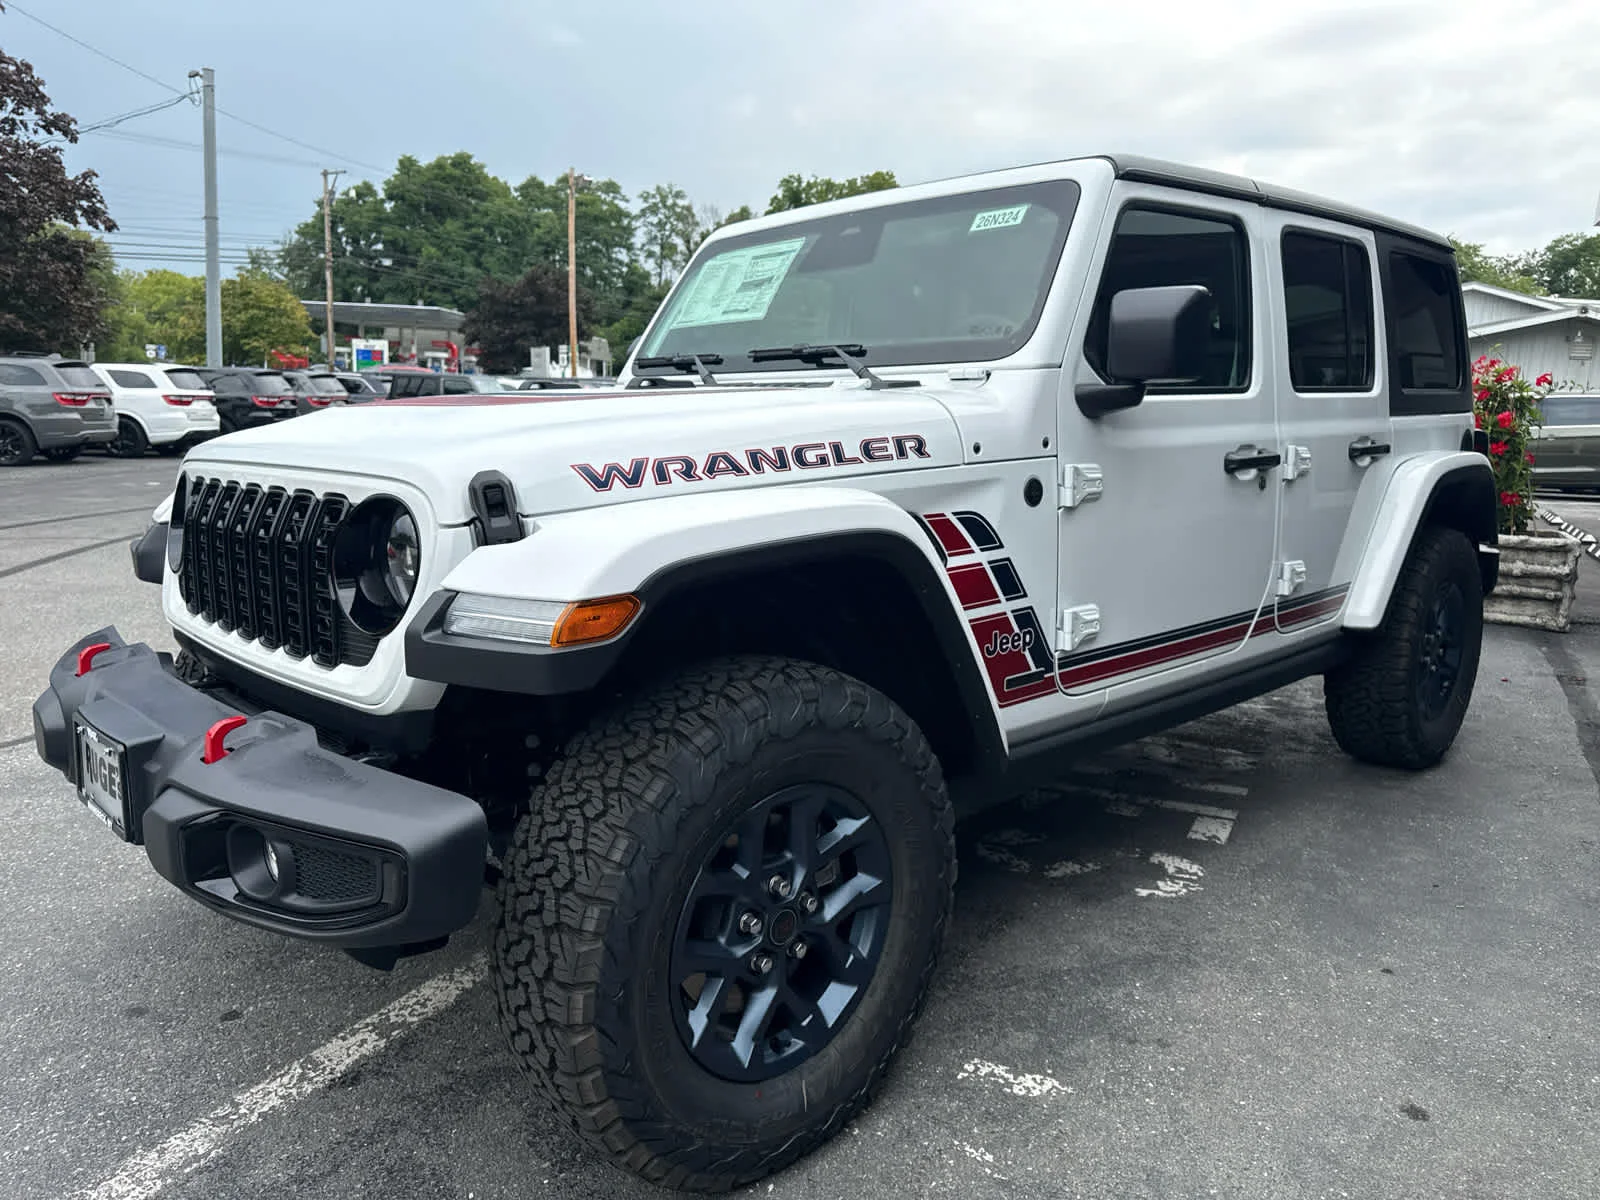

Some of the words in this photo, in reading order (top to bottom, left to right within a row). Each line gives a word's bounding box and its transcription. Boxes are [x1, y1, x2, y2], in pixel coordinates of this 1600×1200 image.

[975, 209, 1021, 229] 26N324
[570, 434, 931, 492] WRANGLER
[984, 628, 1034, 658] Jeep
